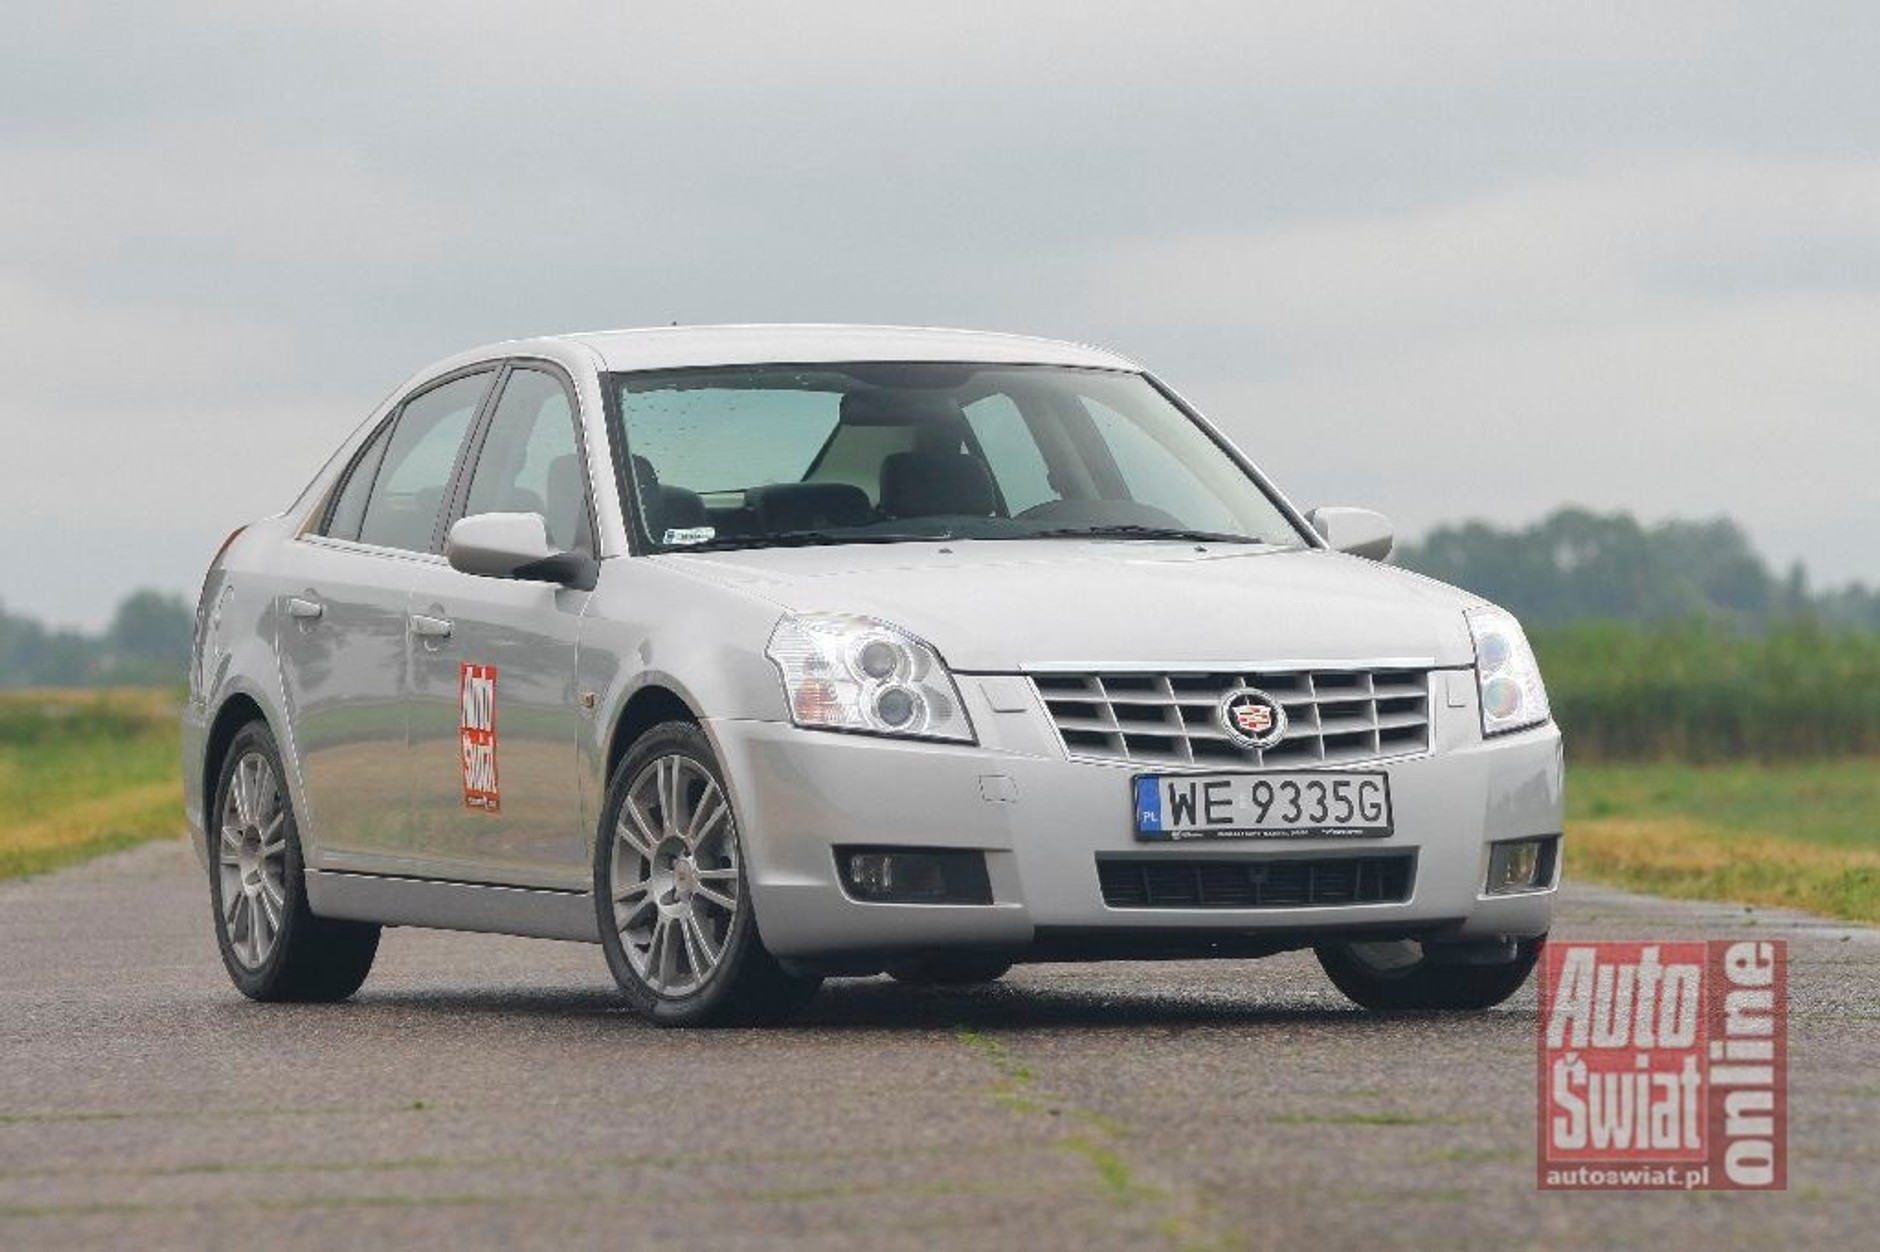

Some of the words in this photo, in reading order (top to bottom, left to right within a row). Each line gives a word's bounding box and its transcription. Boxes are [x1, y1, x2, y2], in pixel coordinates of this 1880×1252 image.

[1143, 811, 1159, 822] PL
[1168, 780, 1234, 825] WE
[1252, 780, 1383, 824] 9335G
